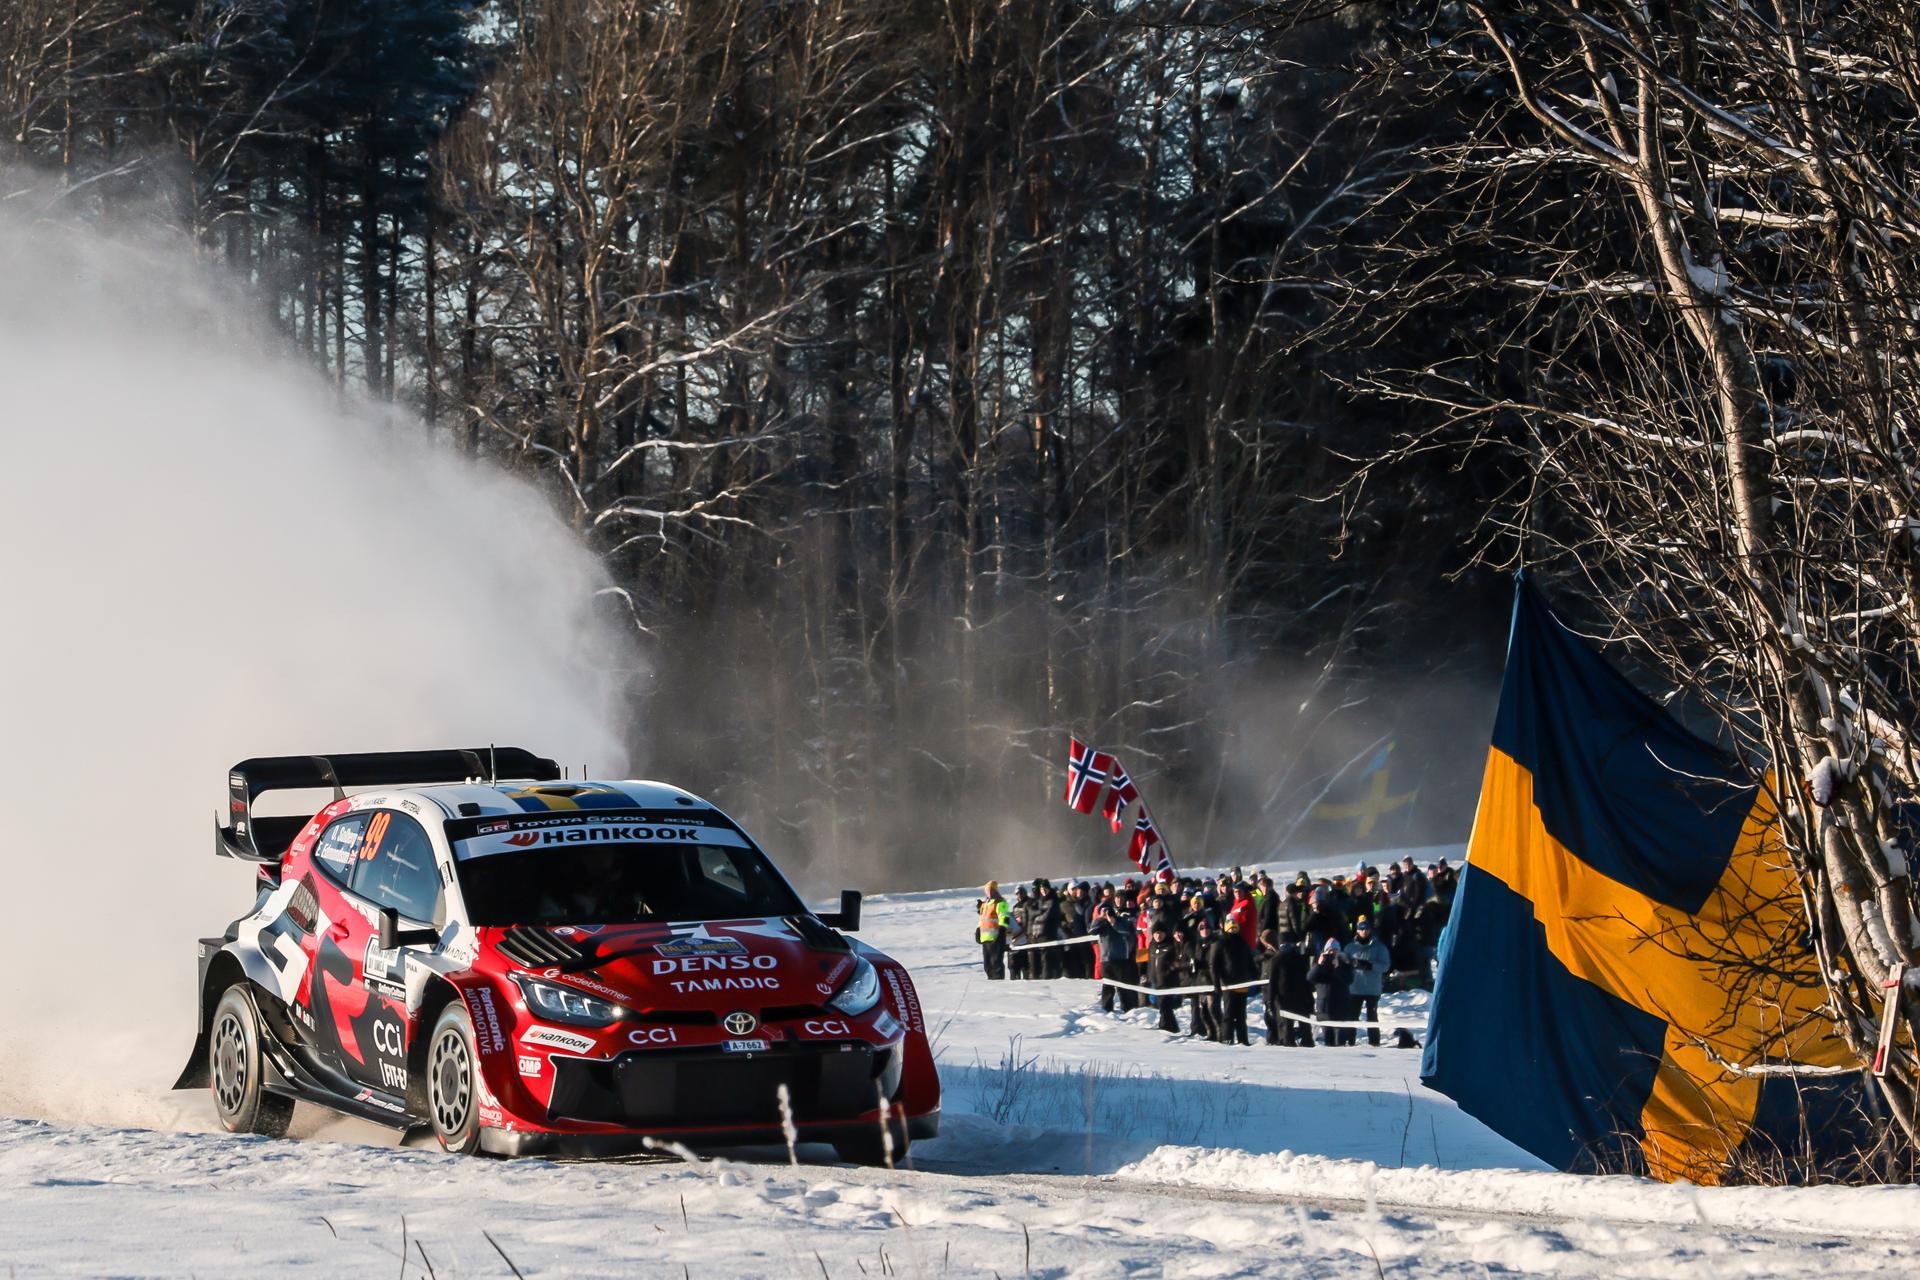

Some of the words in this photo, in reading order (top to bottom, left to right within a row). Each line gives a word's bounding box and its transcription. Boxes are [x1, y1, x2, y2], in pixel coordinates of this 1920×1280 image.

[479, 823, 508, 833] GR
[515, 816, 583, 828] TOYOTA
[586, 815, 646, 823] GAZOO
[360, 812, 391, 861] 99
[652, 955, 778, 975] DENSO
[670, 977, 780, 994] TAMADIC
[884, 968, 911, 1032] Panasonic
[464, 988, 492, 1056] AUTOMOTIVE
[478, 986, 505, 1051] Panasonic
[732, 1041, 762, 1050] A-7662
[518, 1059, 542, 1074] OMP
